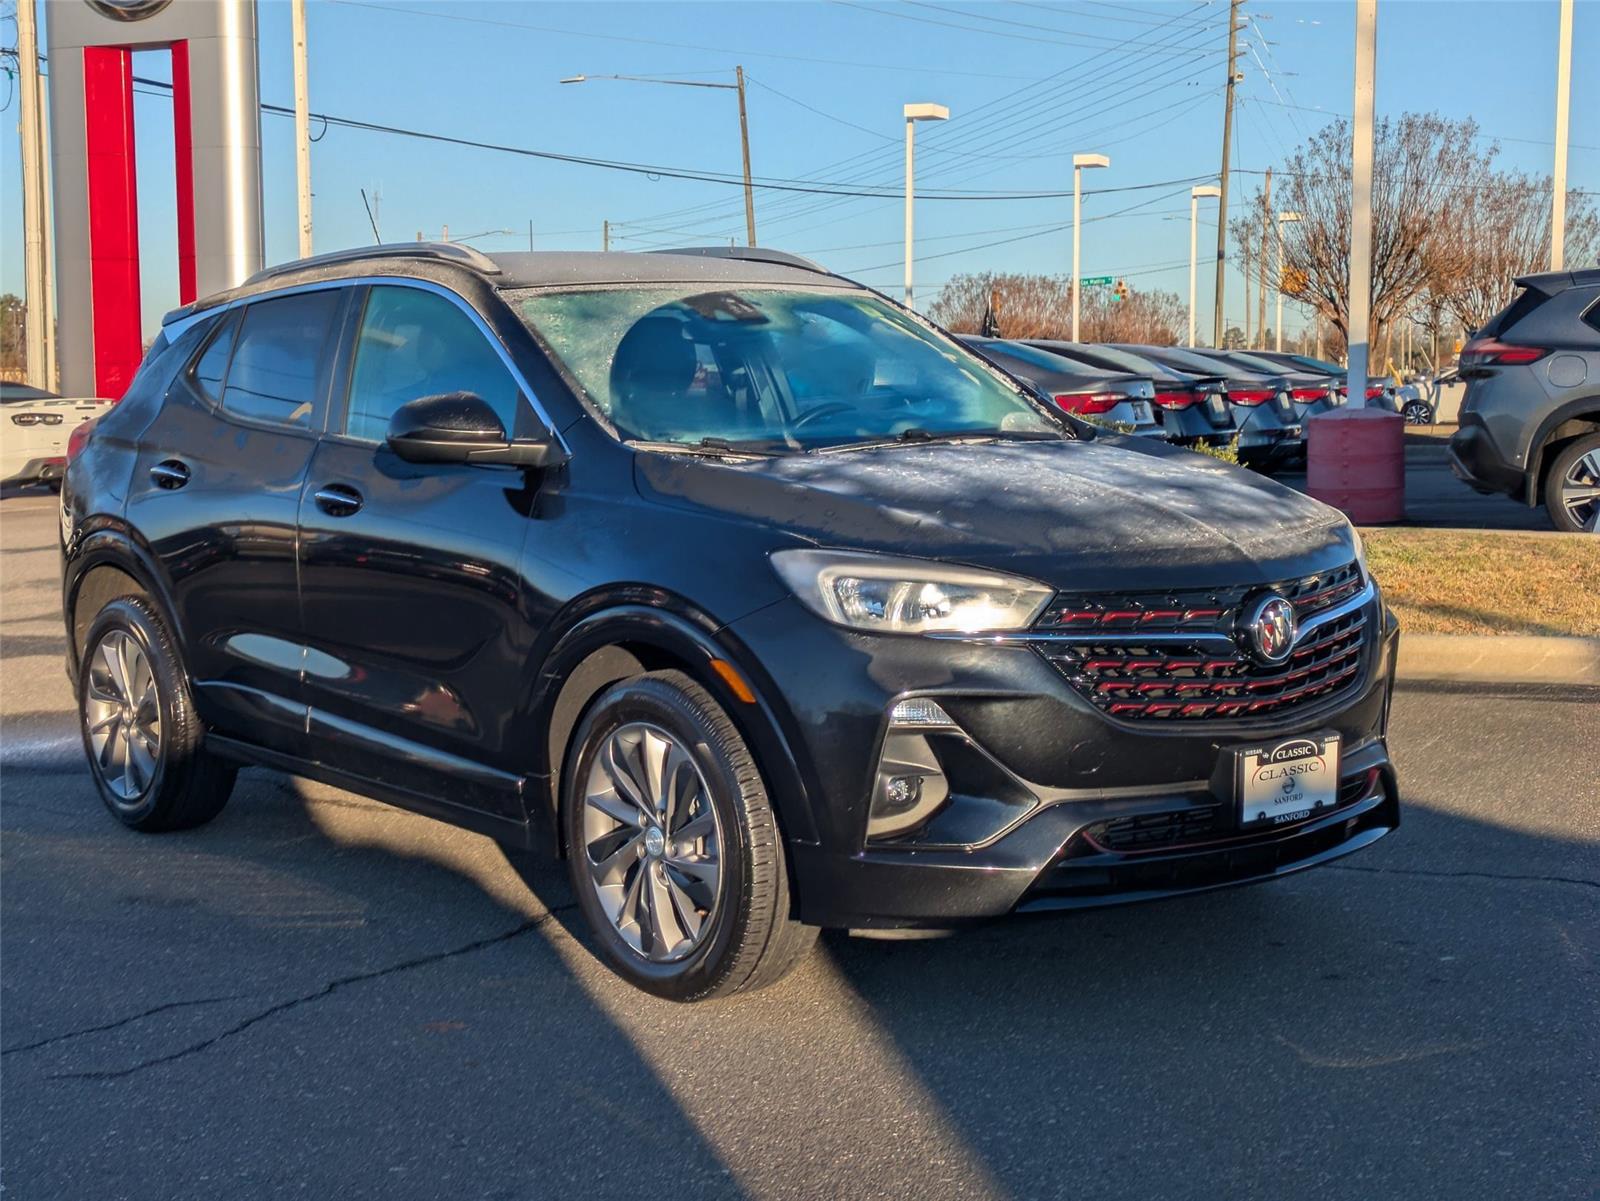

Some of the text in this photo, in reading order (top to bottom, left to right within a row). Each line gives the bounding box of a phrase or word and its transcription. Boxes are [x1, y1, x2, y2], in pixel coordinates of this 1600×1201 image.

[1276, 746, 1312, 759] CLASSIC
[1259, 761, 1318, 781] CLASSIC
[1274, 793, 1303, 805] SANFORD
[1274, 810, 1310, 824] SANFORD
